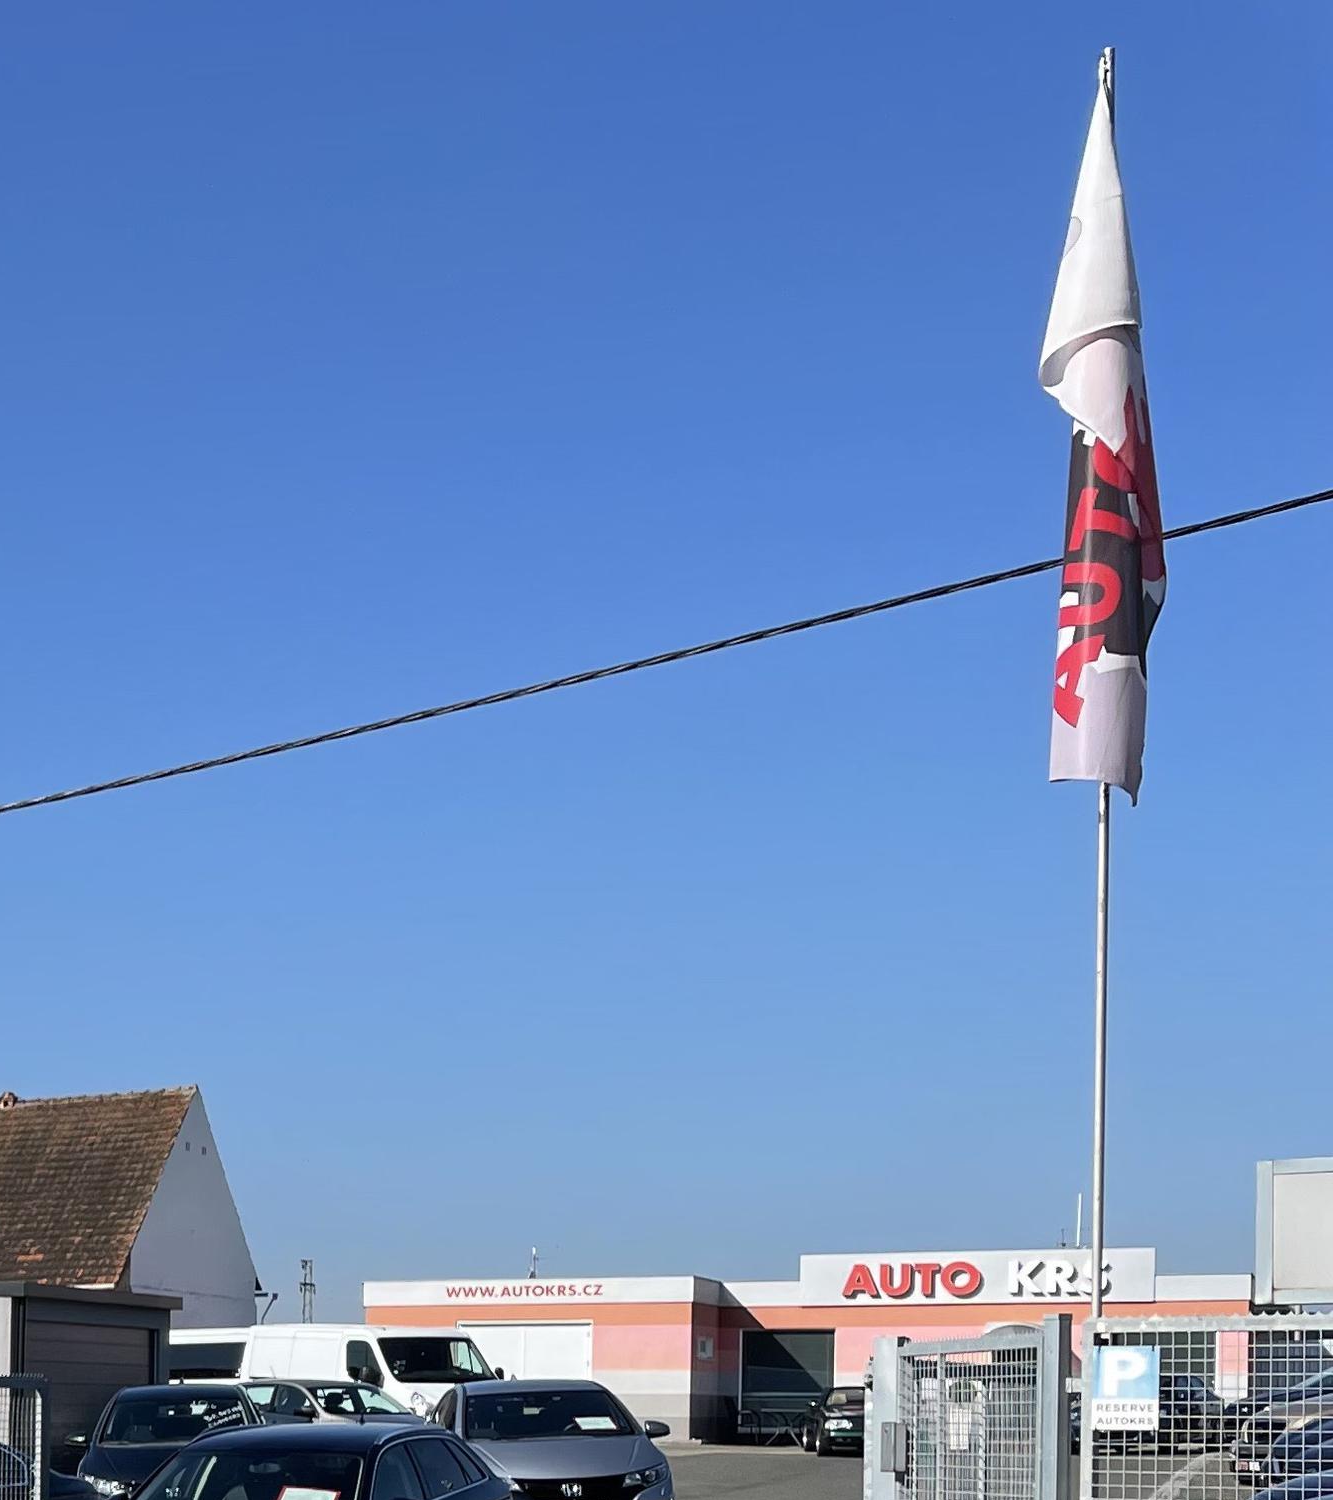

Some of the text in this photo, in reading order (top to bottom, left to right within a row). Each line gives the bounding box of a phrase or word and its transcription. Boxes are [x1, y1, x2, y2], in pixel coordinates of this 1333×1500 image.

[842, 1259, 1113, 1300] AUTO KRS
[446, 1284, 604, 1298] WWW.AUTOKRS.CZ
[1102, 1351, 1148, 1396] P
[1096, 1403, 1155, 1412] RESERVE
[1097, 1417, 1154, 1425] AUTOKRS
